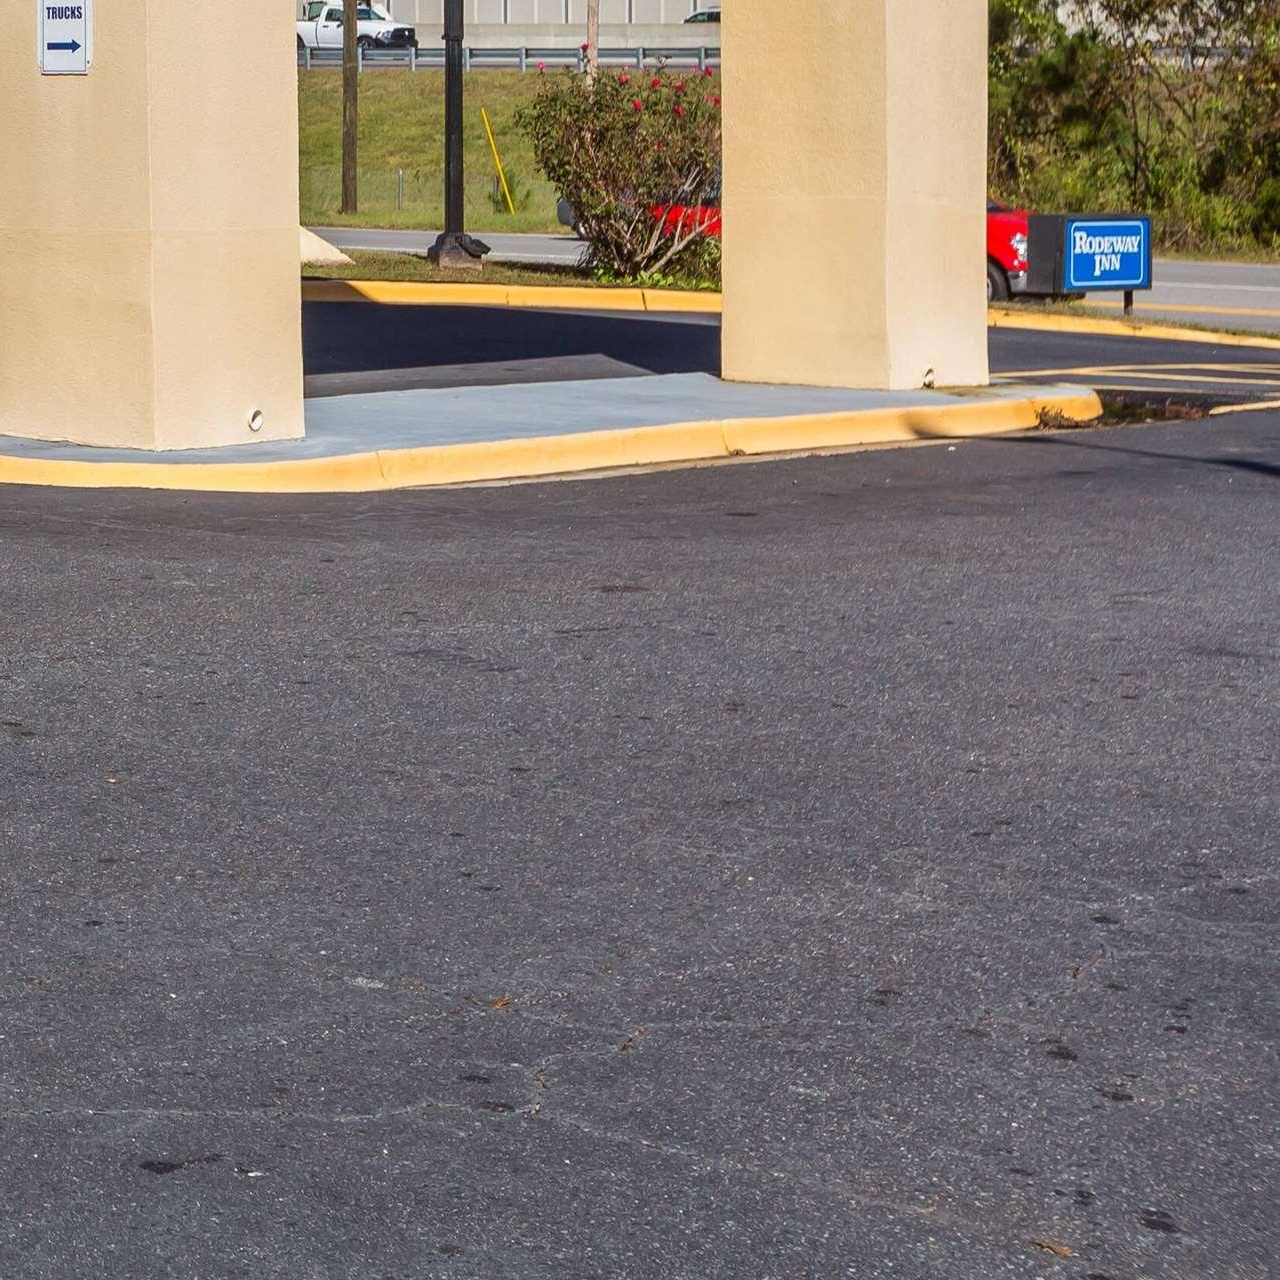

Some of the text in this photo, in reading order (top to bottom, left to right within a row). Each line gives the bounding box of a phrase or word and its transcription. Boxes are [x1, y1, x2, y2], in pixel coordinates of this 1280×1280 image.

[46, 6, 83, 20] TRUCKS
[1074, 231, 1141, 255] RODEWAY
[1093, 254, 1121, 277] INN
